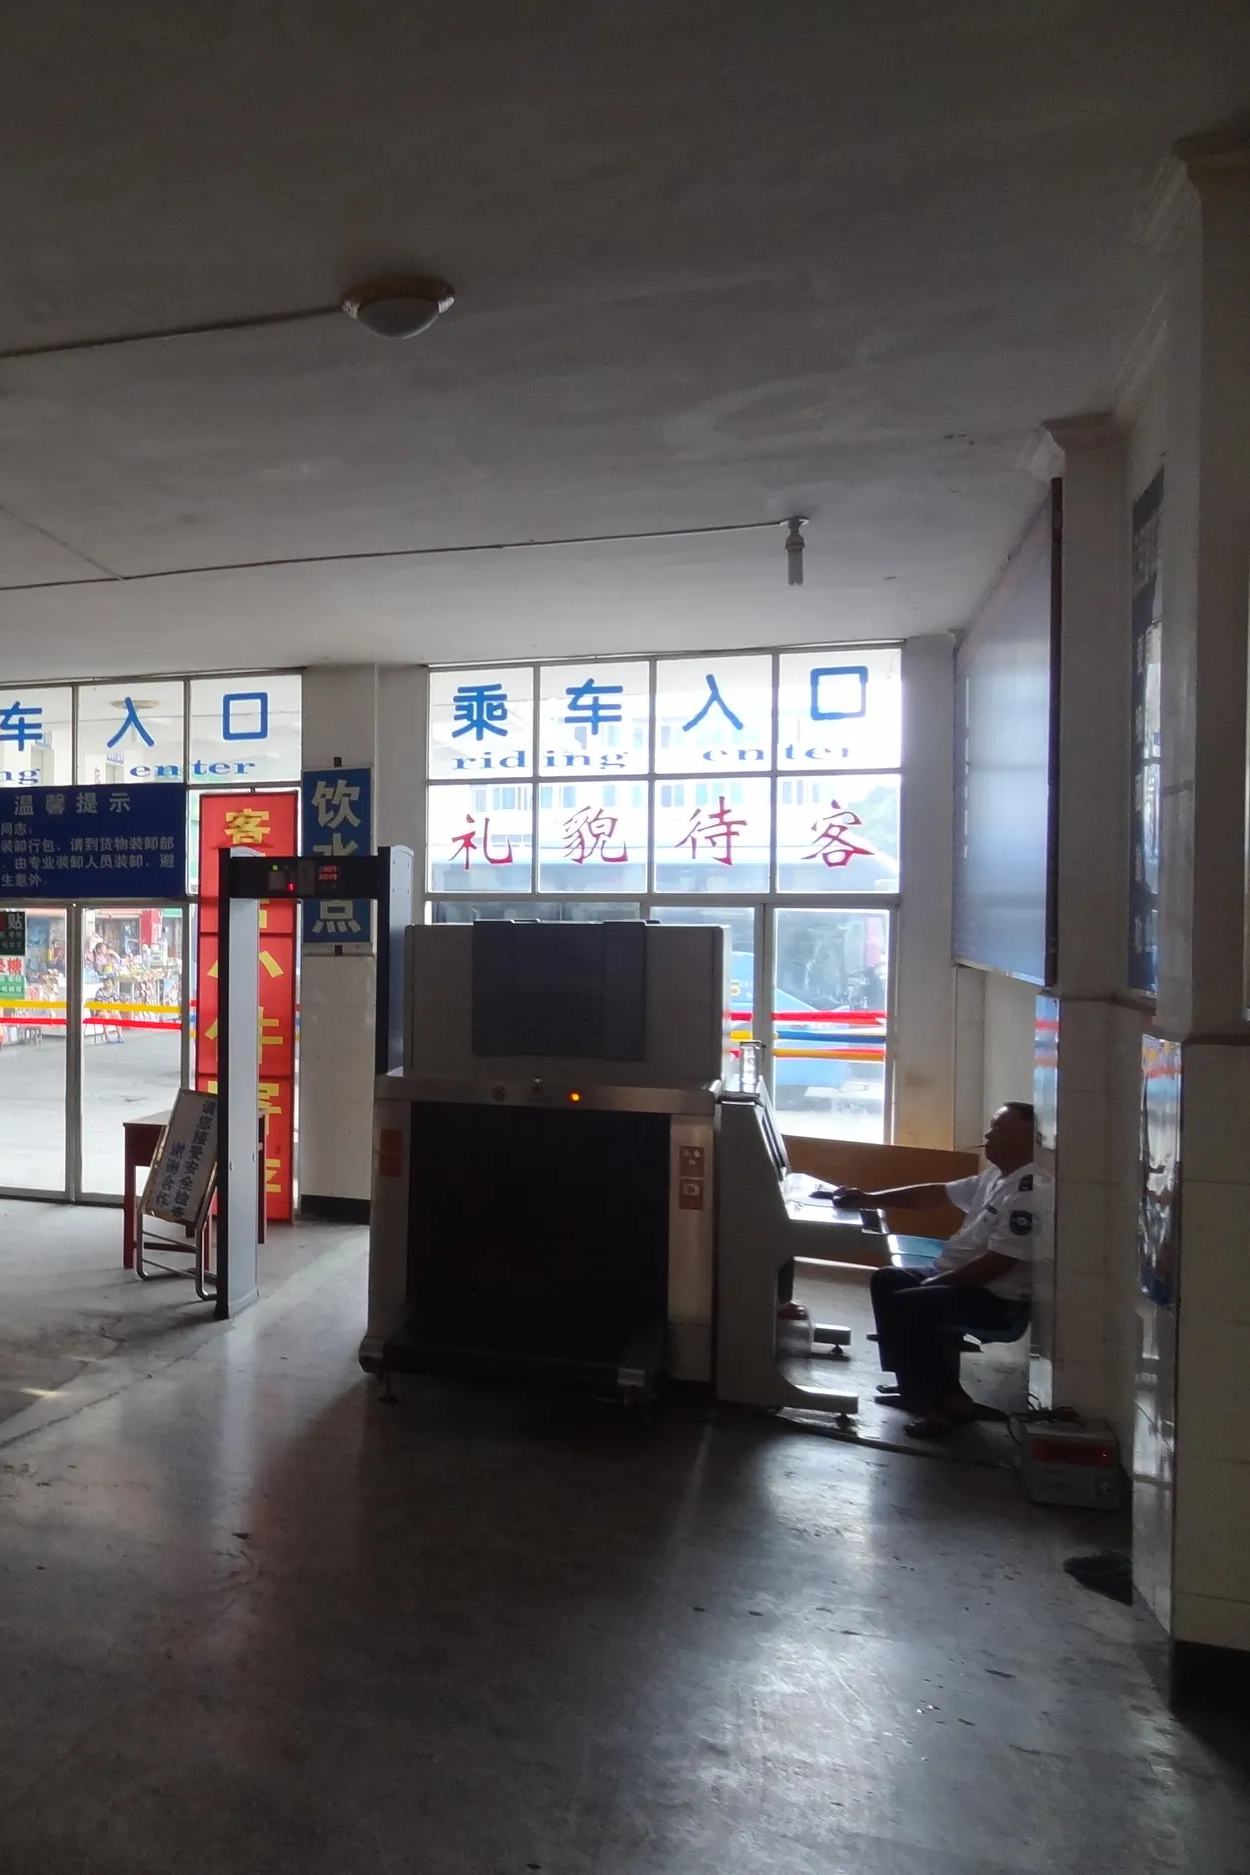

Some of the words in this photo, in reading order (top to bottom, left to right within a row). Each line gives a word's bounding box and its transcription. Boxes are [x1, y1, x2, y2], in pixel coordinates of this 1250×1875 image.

[451, 665, 868, 741] 乘车入口
[129, 760, 255, 778] enter
[452, 750, 629, 770] riding
[14, 791, 131, 816] 温馨提示
[449, 796, 874, 870] 礼貌待客
